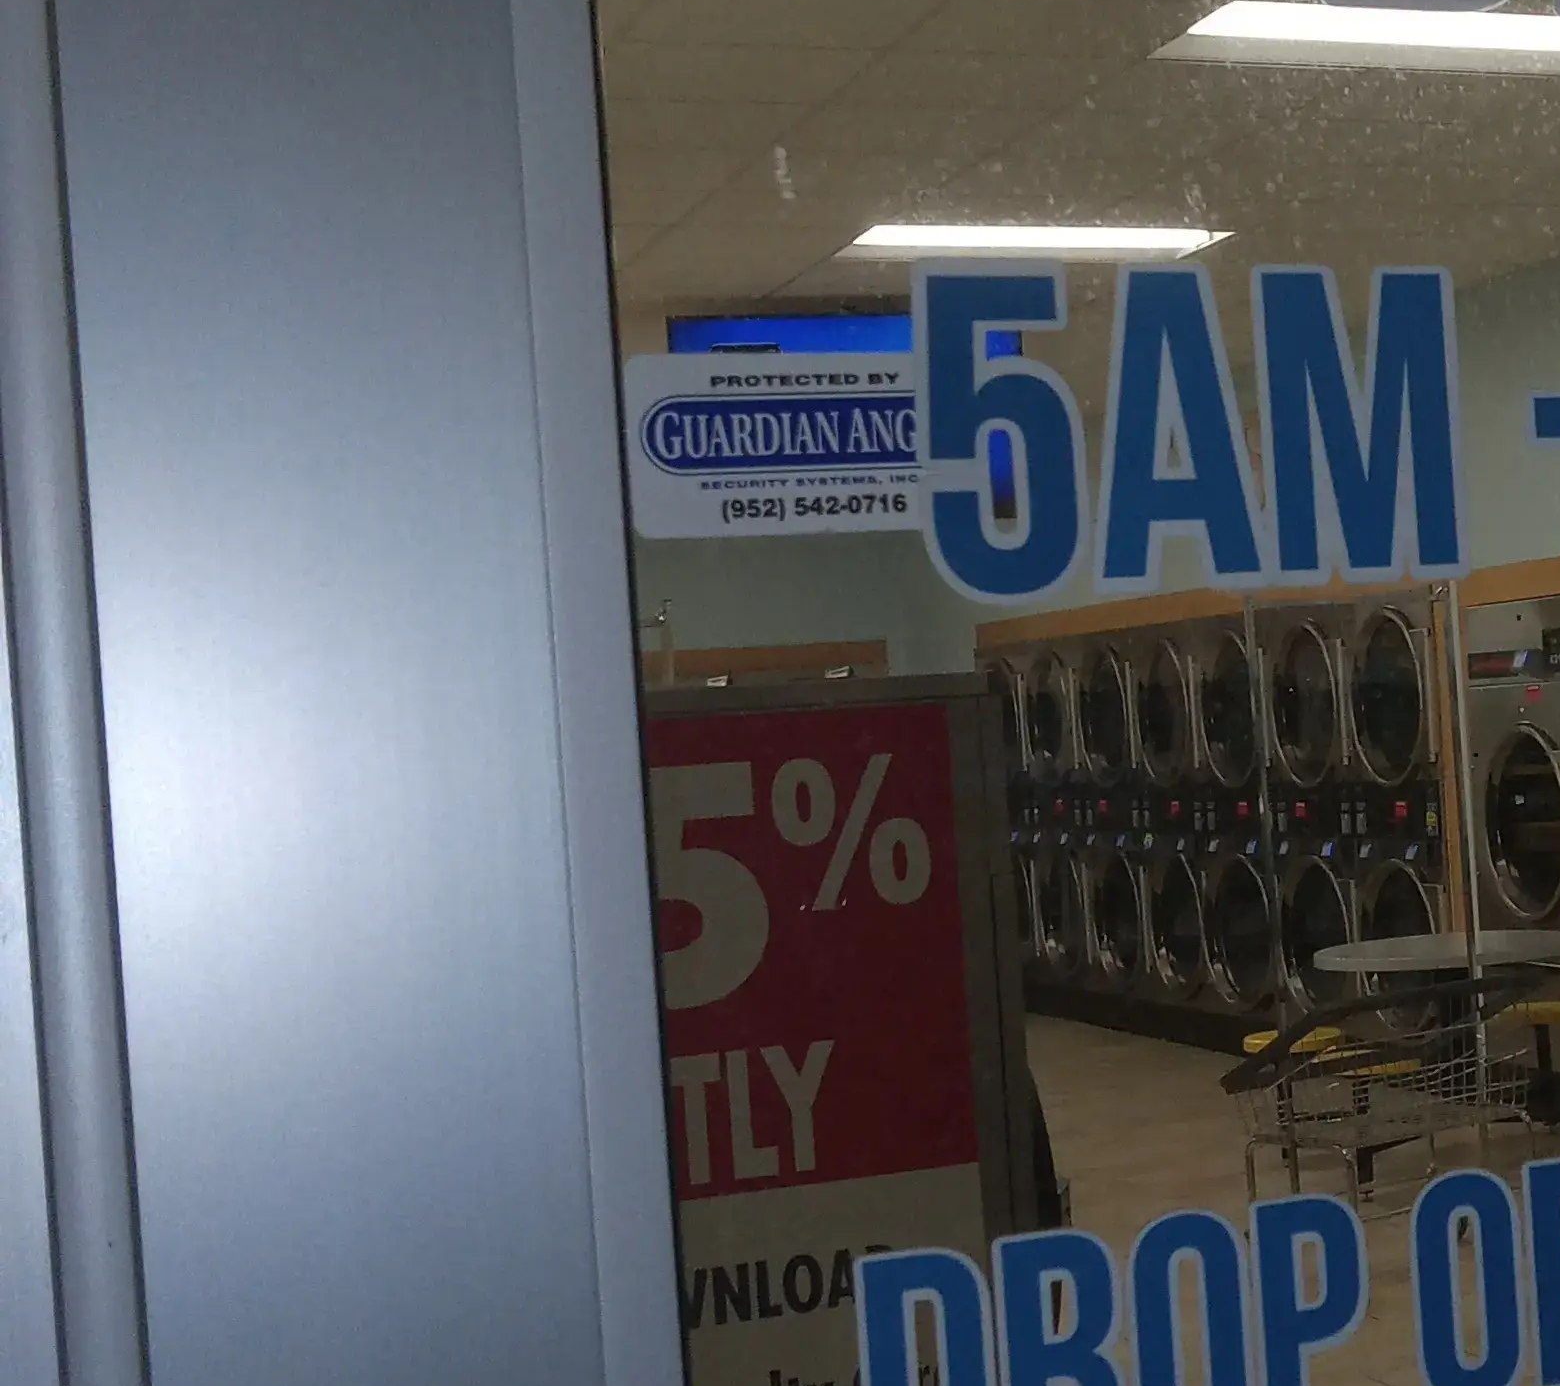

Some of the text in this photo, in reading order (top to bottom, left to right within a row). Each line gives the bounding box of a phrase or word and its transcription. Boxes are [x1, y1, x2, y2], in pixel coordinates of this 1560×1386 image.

[709, 372, 900, 388] PROTECTED BY
[653, 410, 841, 460] GUARDIAN
[918, 266, 1466, 599] 5AM
[700, 479, 788, 491] SECURITY
[794, 475, 884, 488] SYSTEMS,
[721, 492, 908, 524] (952) 542-0716
